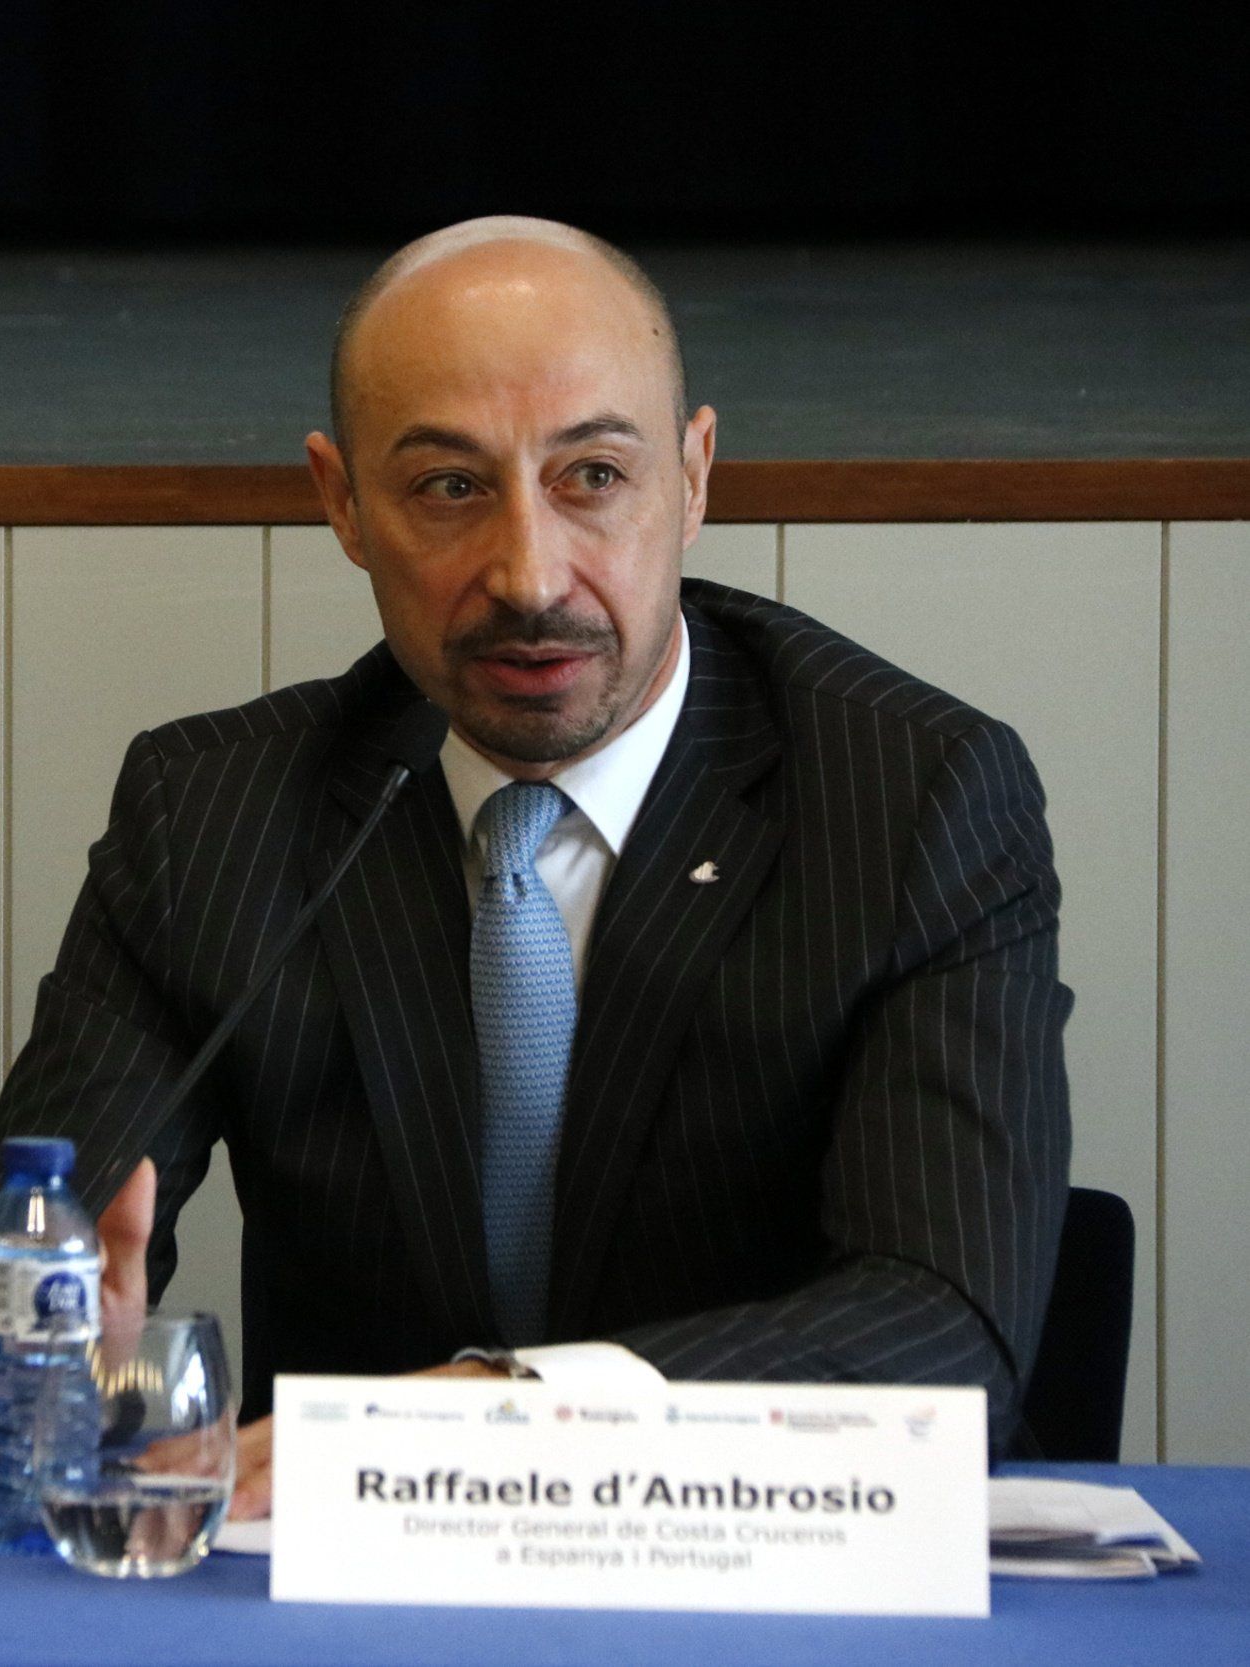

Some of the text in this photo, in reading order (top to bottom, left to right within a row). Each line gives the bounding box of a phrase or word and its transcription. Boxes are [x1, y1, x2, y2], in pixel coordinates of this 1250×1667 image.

[356, 1467, 572, 1506] Raffaele
[403, 1514, 847, 1545] Director General de Costa Cruceros
[497, 1548, 512, 1565] a
[520, 1546, 624, 1569] Espanya
[649, 1549, 752, 1574] Portugal
